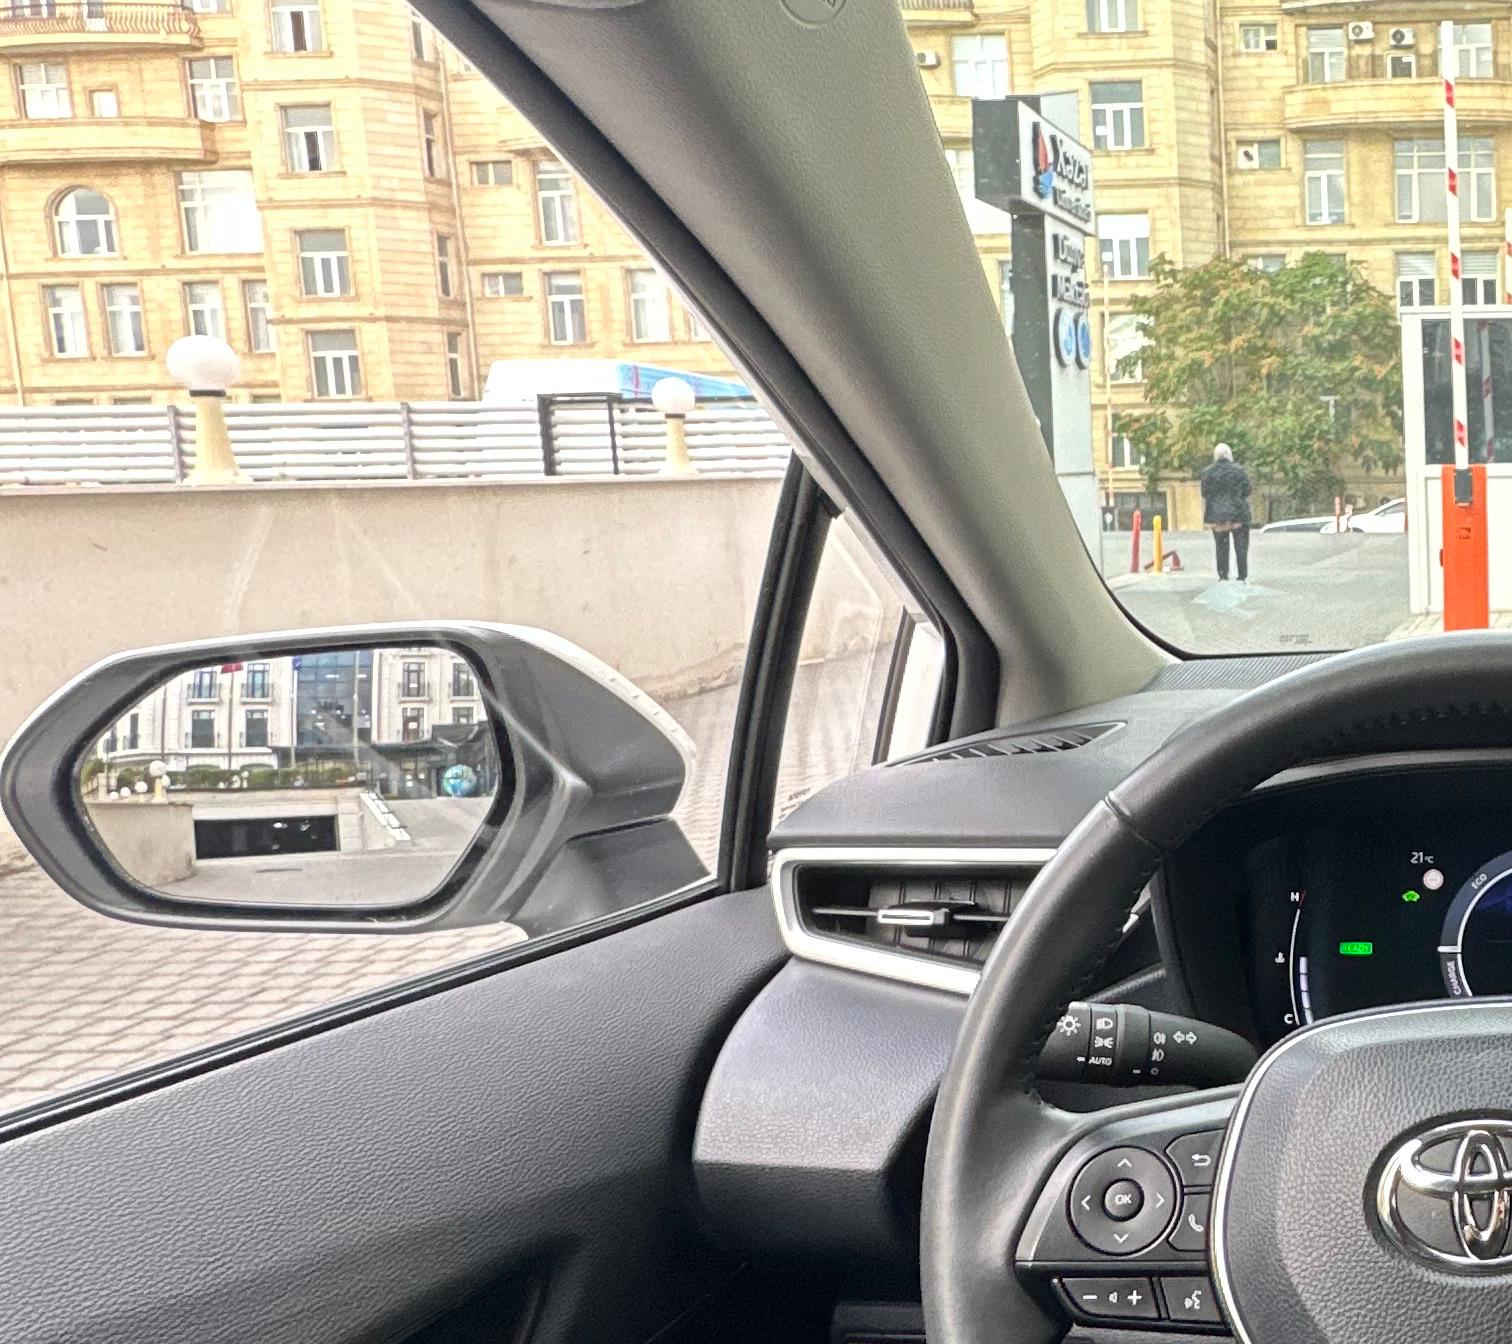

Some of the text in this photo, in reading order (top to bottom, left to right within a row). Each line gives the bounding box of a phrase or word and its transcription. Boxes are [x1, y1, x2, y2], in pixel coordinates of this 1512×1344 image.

[1470, 872, 1488, 890] ECO
[1284, 1014, 1294, 1025] C
[1088, 1055, 1113, 1067] AUTO
[1114, 1193, 1133, 1206] OK
